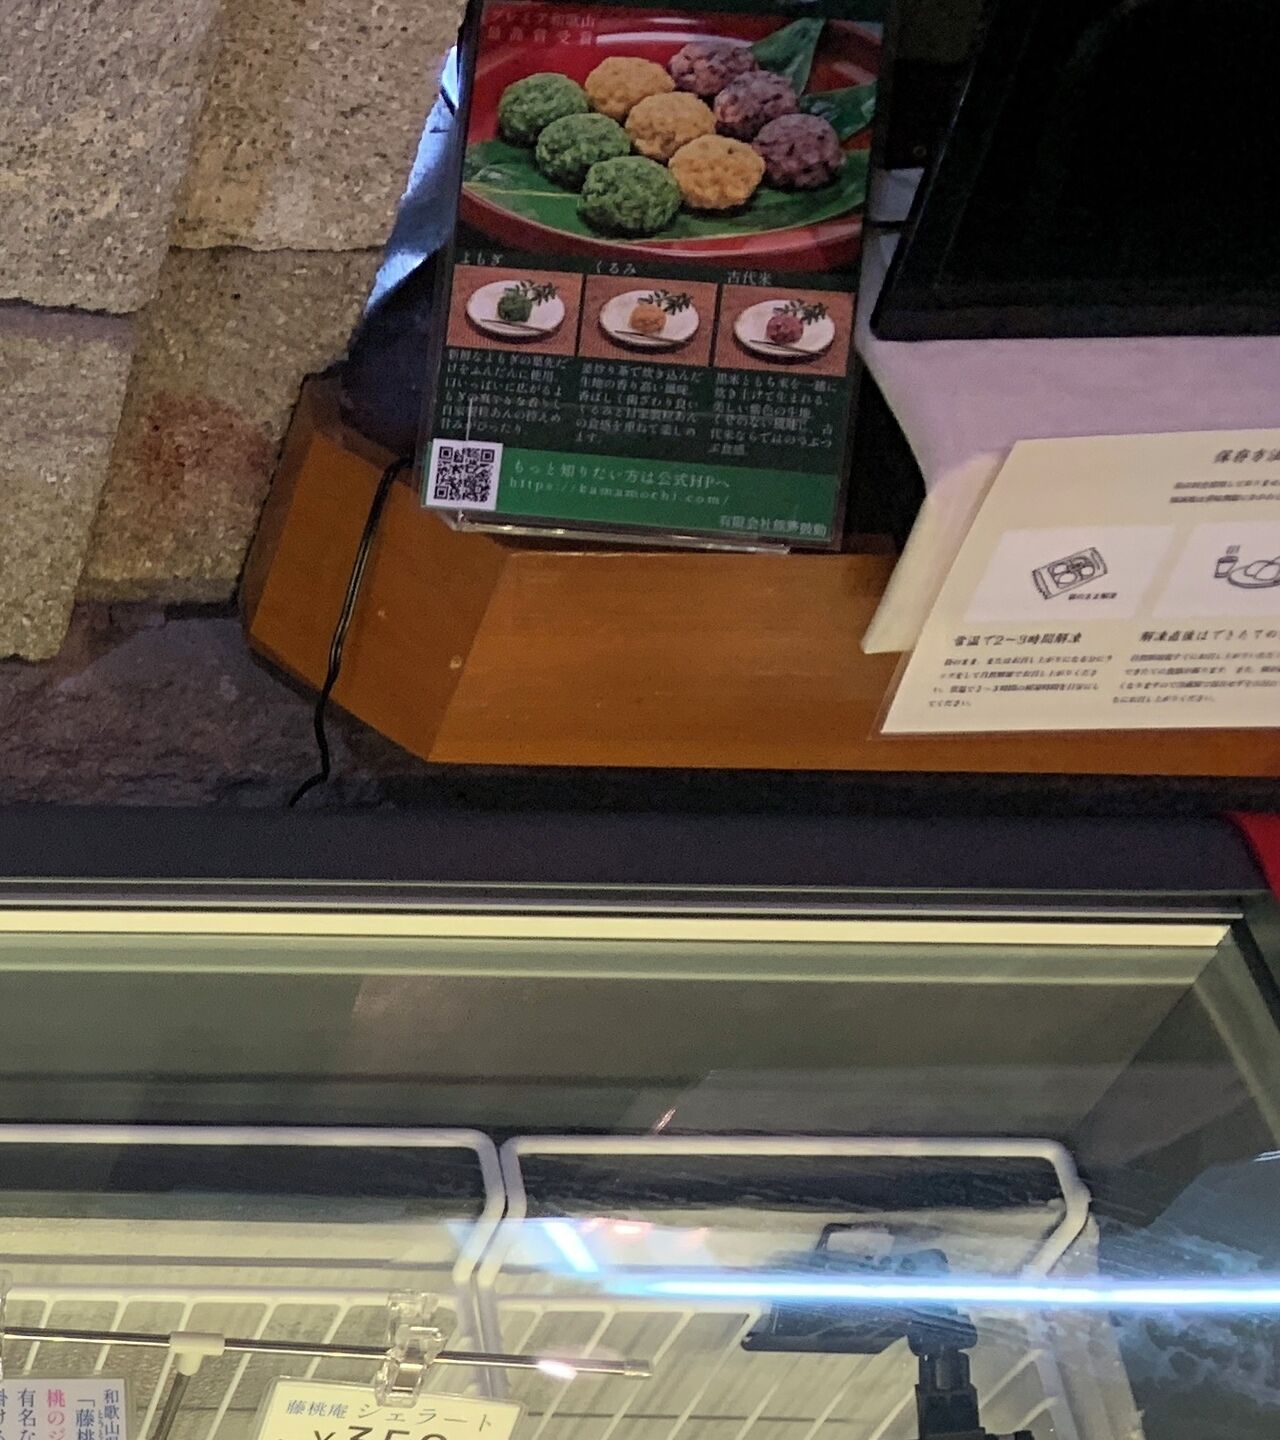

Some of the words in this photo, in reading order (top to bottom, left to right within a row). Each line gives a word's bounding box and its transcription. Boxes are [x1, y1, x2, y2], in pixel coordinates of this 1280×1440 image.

[594, 261, 637, 275] くるみ
[726, 271, 773, 286] 古代米
